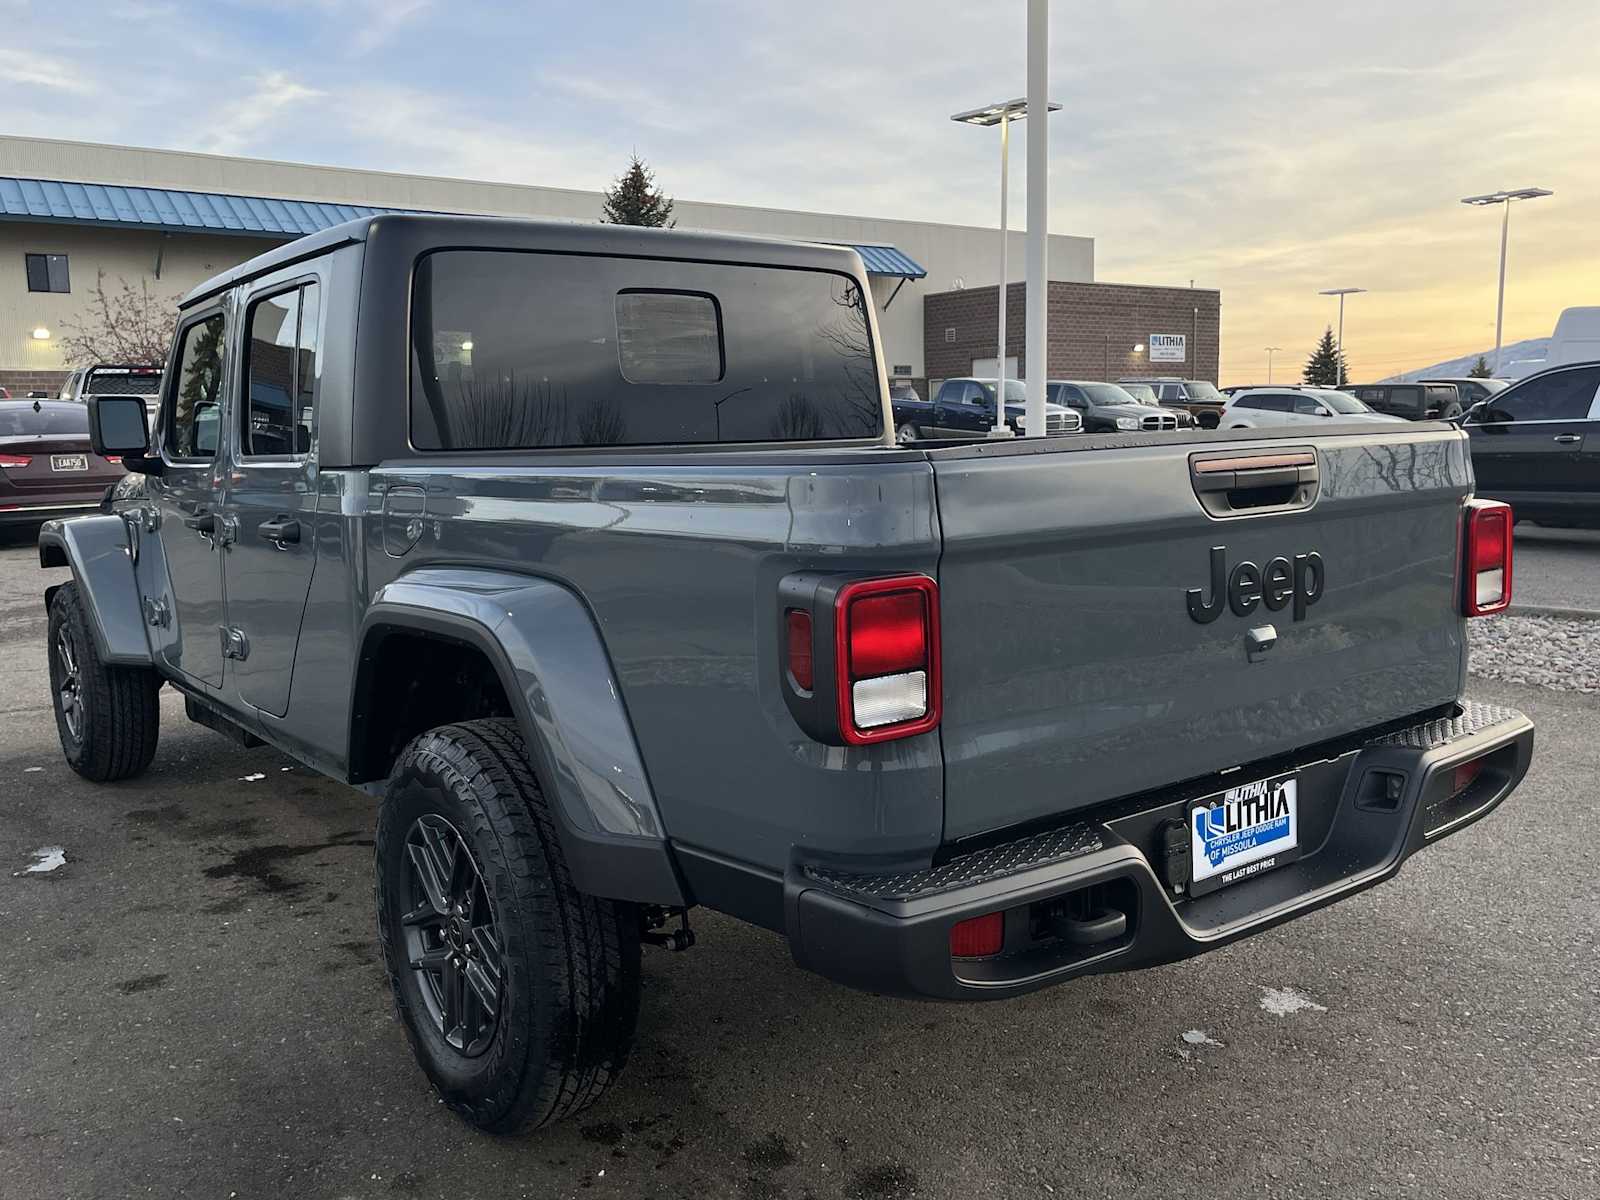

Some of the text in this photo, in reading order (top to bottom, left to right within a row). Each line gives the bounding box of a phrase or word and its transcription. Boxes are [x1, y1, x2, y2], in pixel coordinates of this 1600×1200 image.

[1158, 336, 1184, 347] LITHIA
[1186, 545, 1325, 624] Jeep
[1234, 781, 1268, 802] LITHIA
[1226, 788, 1290, 834] LITHIA
[1210, 818, 1287, 849] CHRYSLER JEEP DODGE RAM
[1210, 837, 1257, 860] OF MISSOULA
[1222, 857, 1275, 883] THE LAST BEST PRICE
